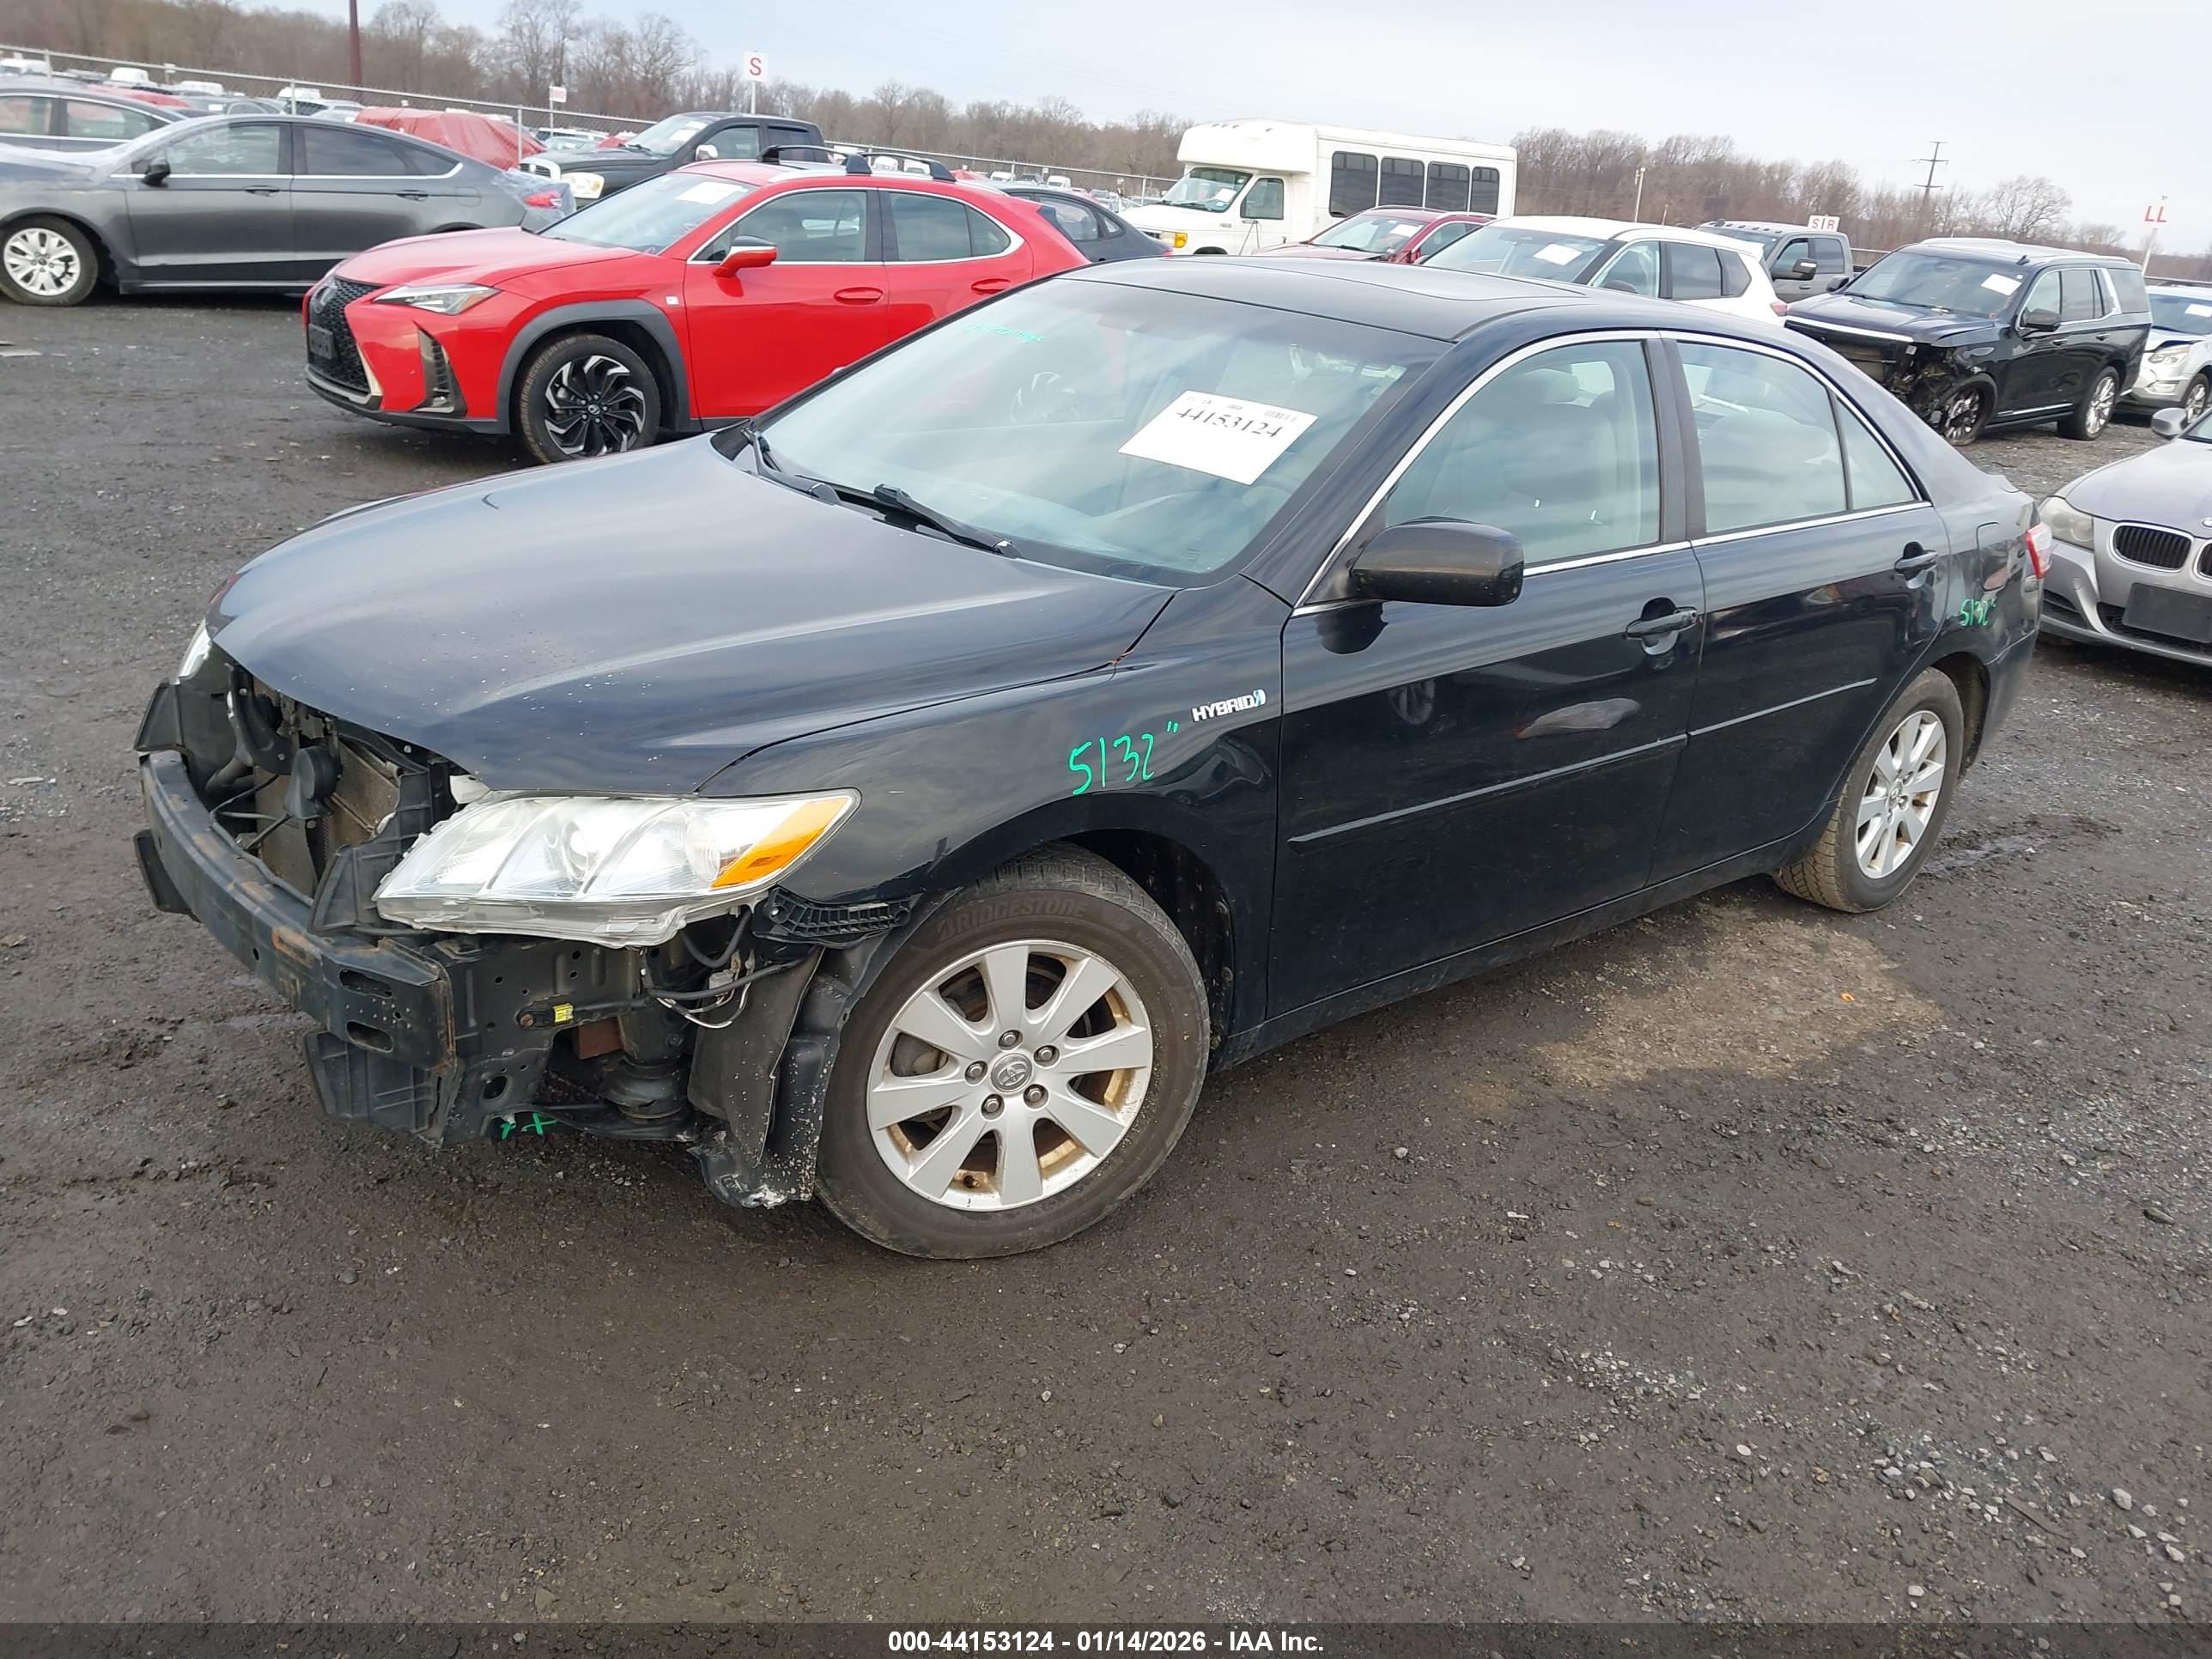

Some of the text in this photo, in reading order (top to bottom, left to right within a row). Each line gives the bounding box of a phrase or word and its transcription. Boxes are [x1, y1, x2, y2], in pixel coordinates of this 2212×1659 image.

[749, 57, 762, 76] S
[2144, 205, 2167, 222] LL
[1176, 407, 1284, 438] 44153124
[1191, 694, 1255, 722] HYBRID
[935, 900, 1087, 941] BRIDGESTONE
